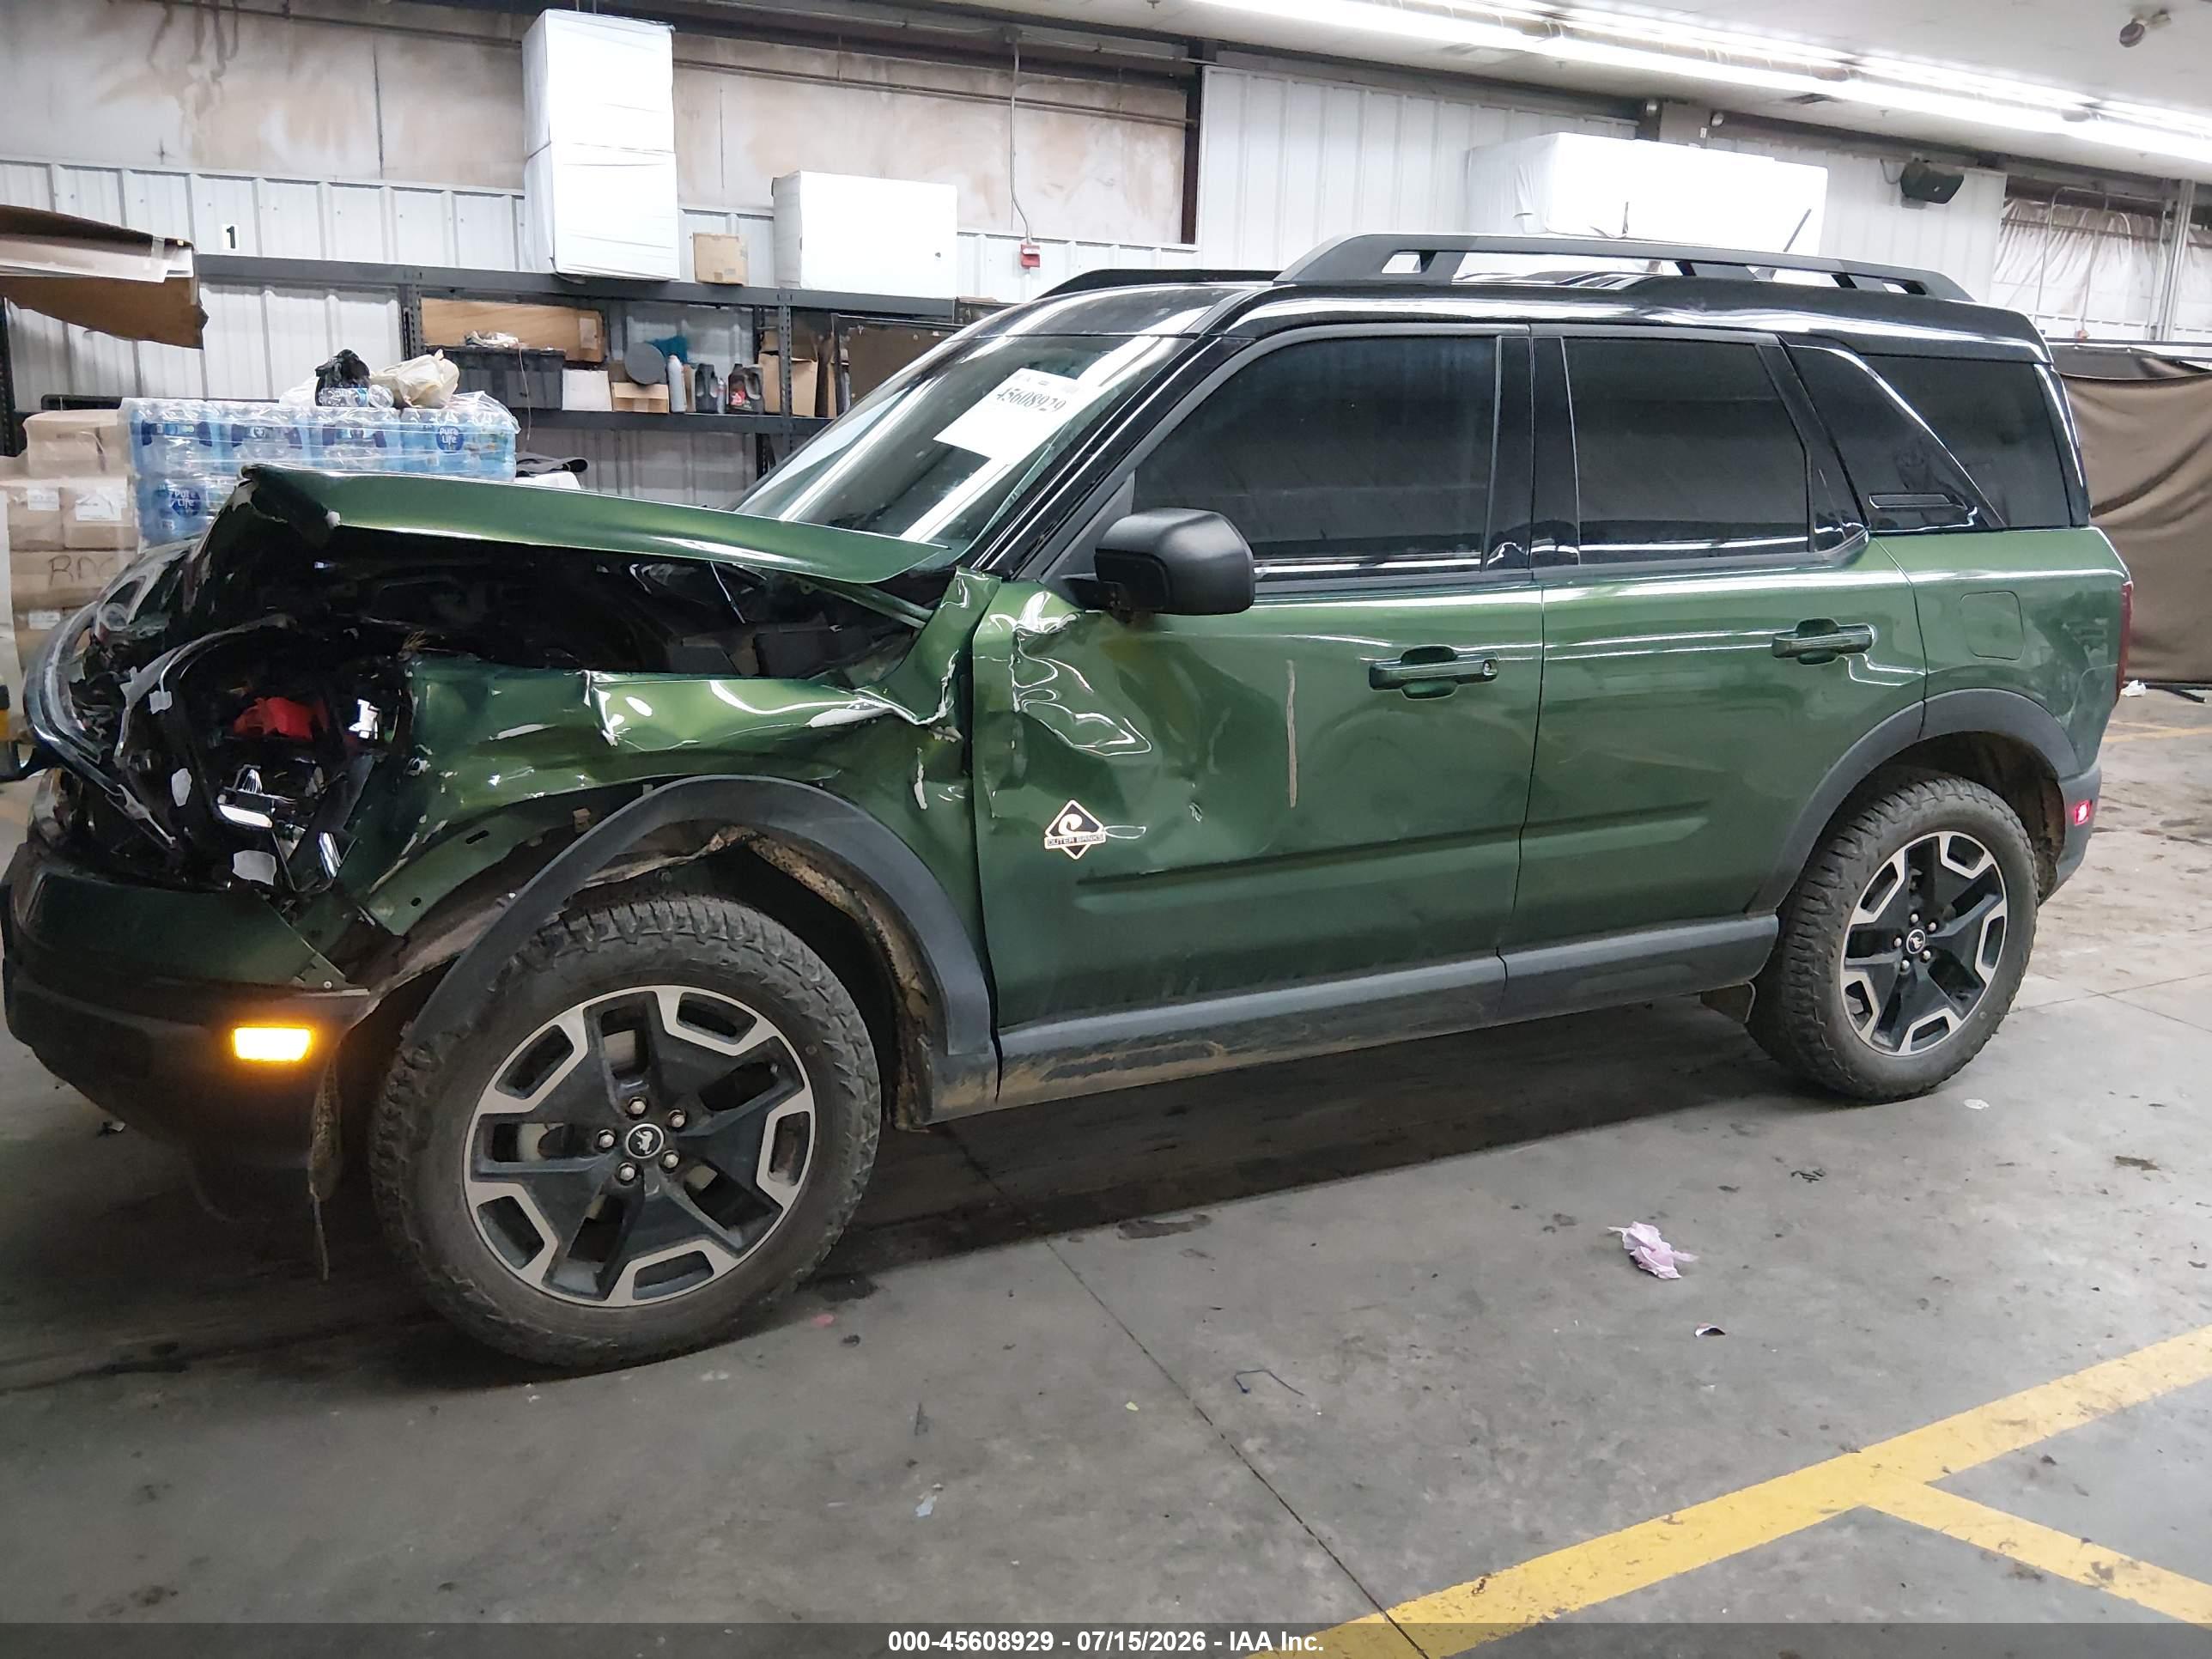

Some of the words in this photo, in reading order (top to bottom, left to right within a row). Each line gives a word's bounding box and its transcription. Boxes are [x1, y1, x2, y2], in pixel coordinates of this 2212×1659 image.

[226, 225, 235, 249] 1
[997, 387, 1066, 412] 45608929
[441, 435, 459, 446] Life
[177, 497, 195, 509] Life
